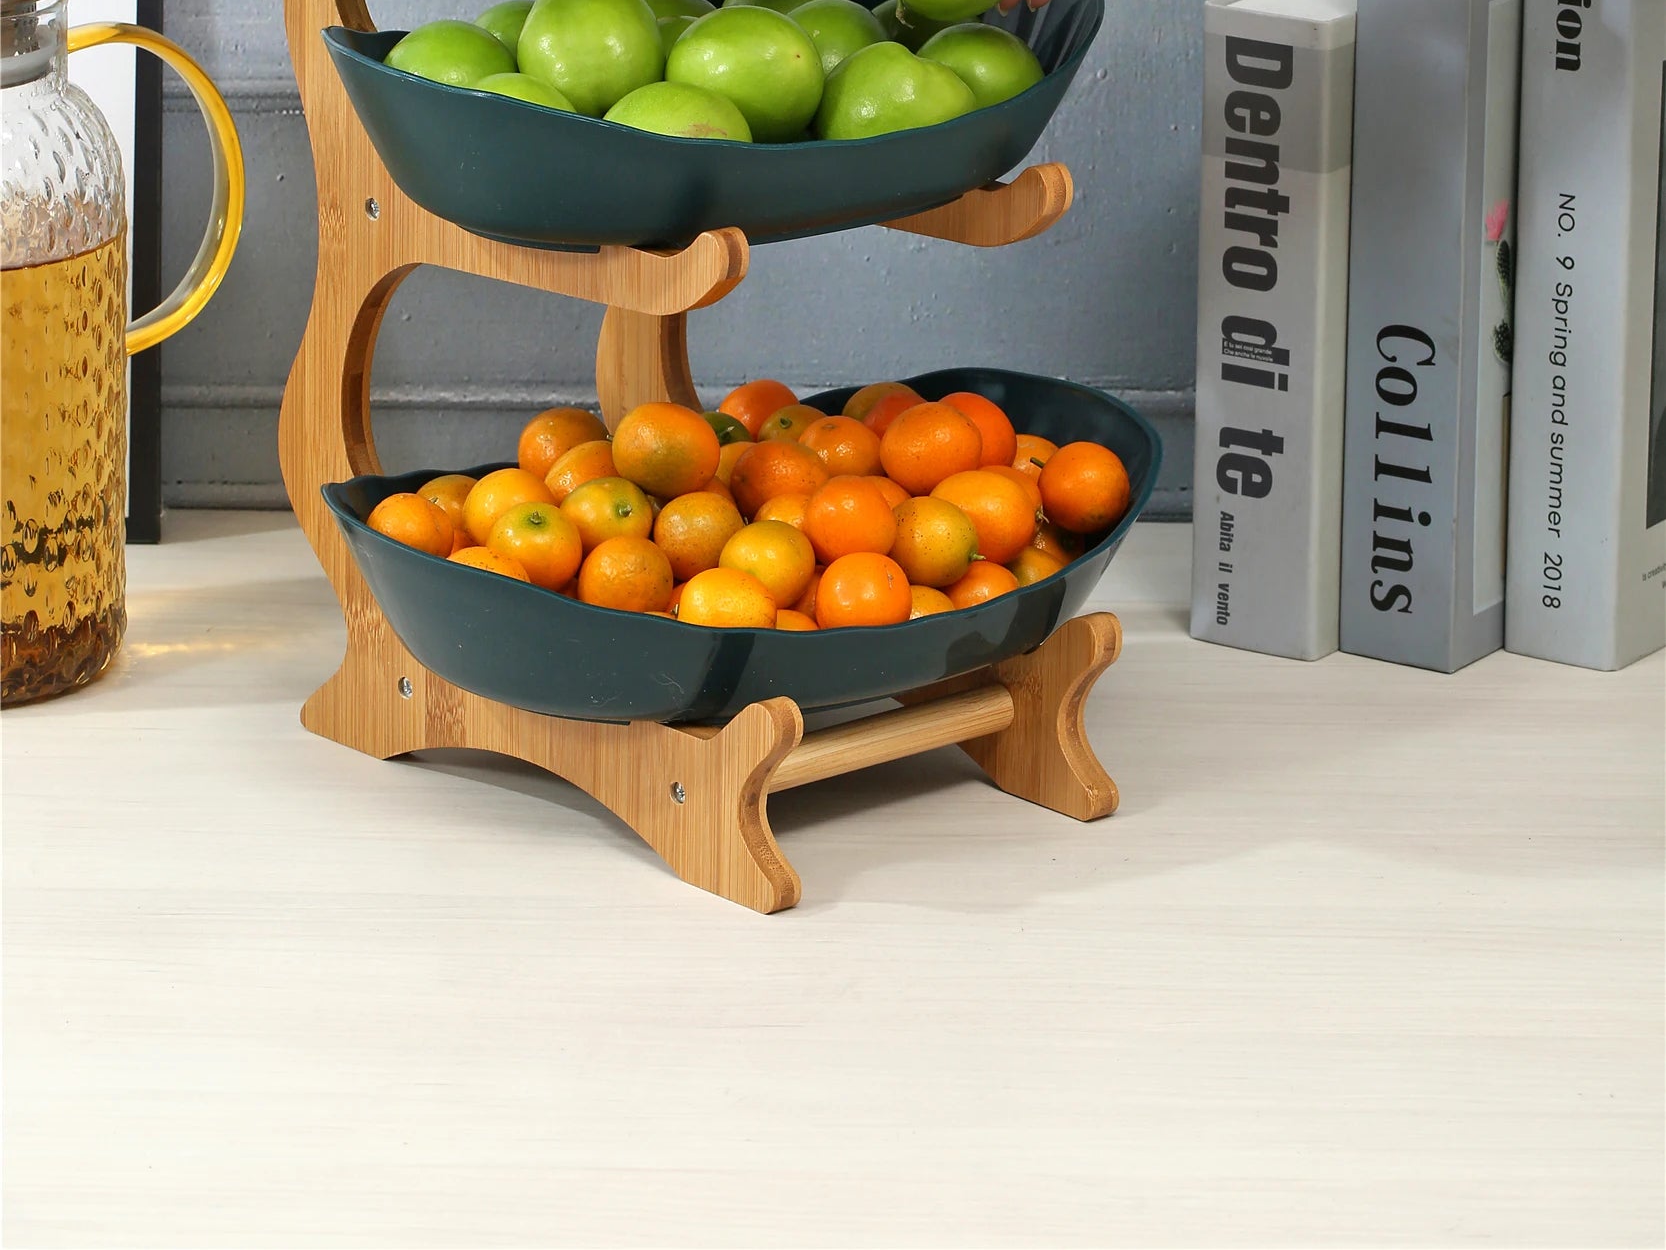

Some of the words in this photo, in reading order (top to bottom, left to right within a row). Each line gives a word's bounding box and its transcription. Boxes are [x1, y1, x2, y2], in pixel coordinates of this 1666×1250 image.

[1222, 35, 1294, 293] Dentro
[1557, 193, 1576, 238] NO.
[1555, 256, 1575, 271] 9
[1221, 315, 1290, 392] di
[1549, 282, 1574, 368] Spring
[1551, 375, 1569, 426] and
[1216, 426, 1285, 499] te
[1369, 324, 1437, 615] Collins
[1548, 432, 1564, 538] summer
[1219, 510, 1235, 552] Abita
[1218, 561, 1233, 573] il
[1542, 551, 1563, 609] 2018
[1216, 583, 1231, 626] vento
